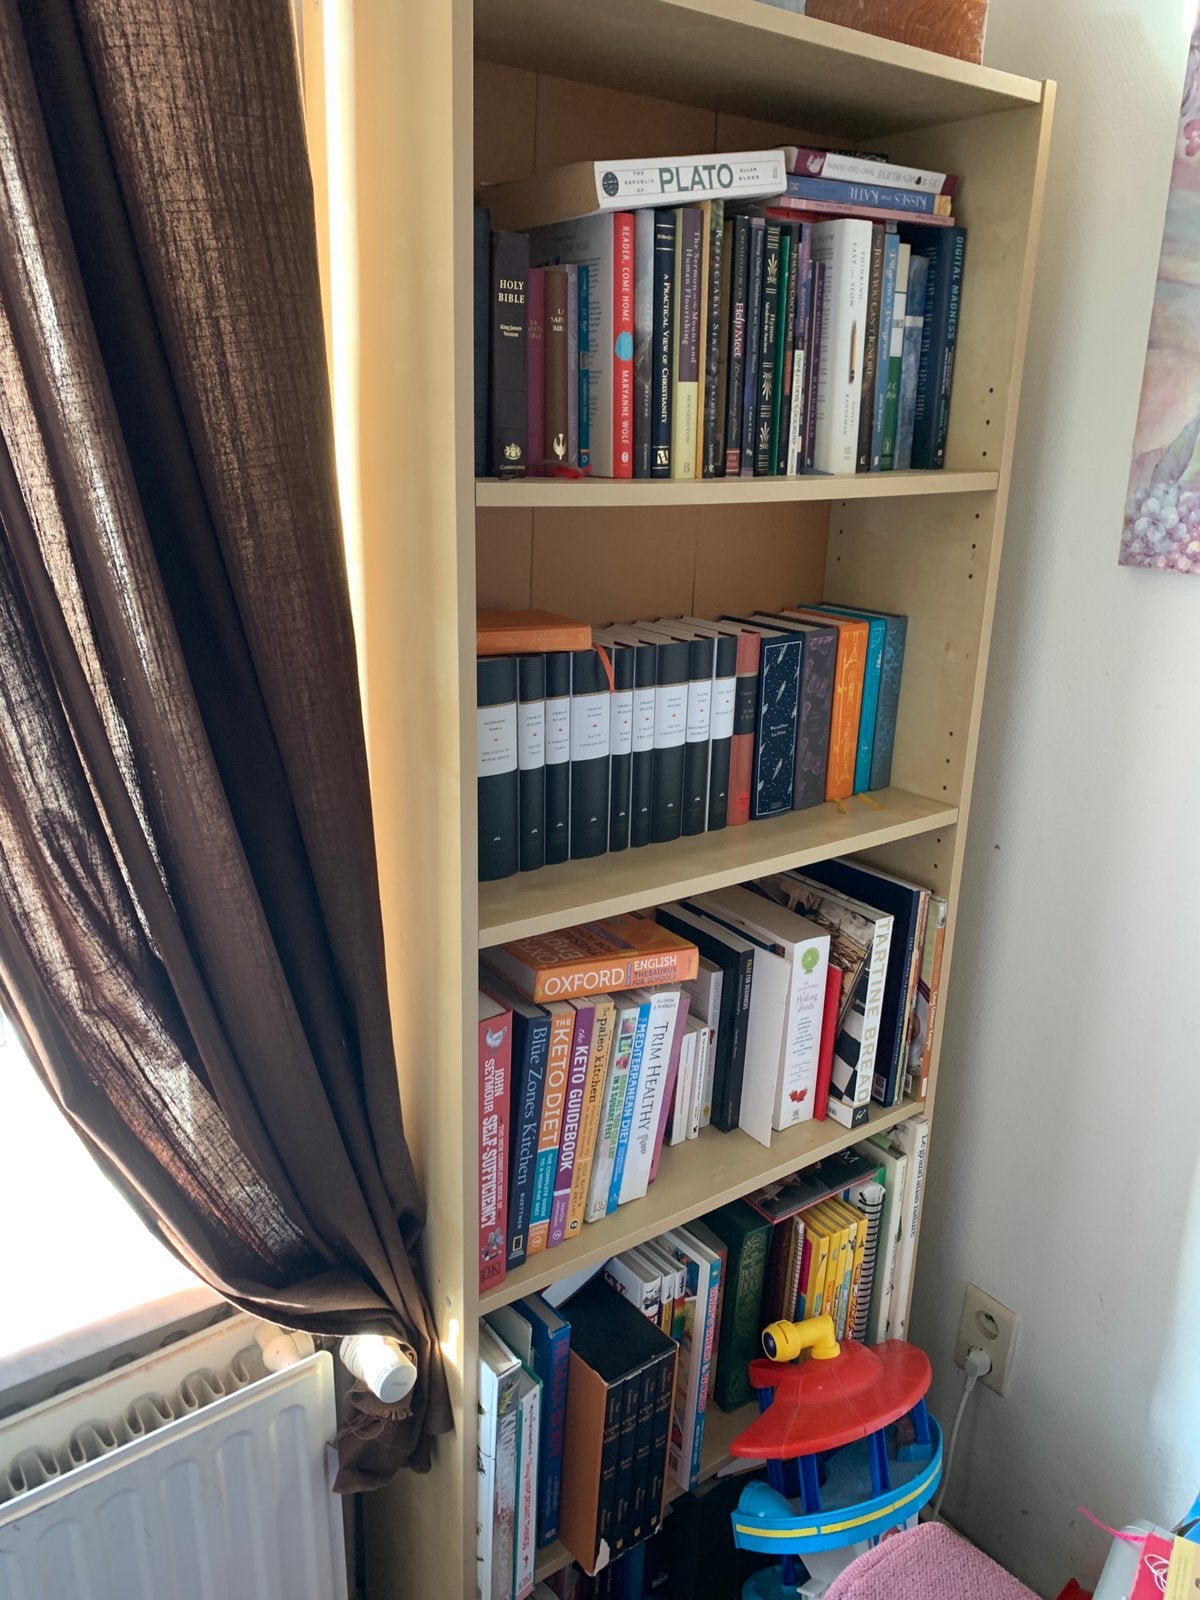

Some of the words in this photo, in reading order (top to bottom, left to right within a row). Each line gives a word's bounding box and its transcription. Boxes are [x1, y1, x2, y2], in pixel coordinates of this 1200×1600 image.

[659, 164, 733, 193] PLATO
[849, 186, 879, 204] KATIE
[895, 193, 927, 209] KISSES
[622, 225, 630, 263] READER,
[692, 230, 700, 249] The
[692, 252, 700, 291] Sermon
[753, 257, 761, 277] Godly
[873, 248, 881, 276] JESUS
[953, 236, 964, 280] DIGITAL
[498, 293, 525, 303] BIBLE
[500, 280, 524, 290] HOLY
[871, 277, 879, 299] YOU
[661, 282, 670, 328] PRACTICAL
[682, 288, 692, 345] Flourishing
[733, 302, 744, 328] Help
[947, 285, 960, 339] MADNESS
[661, 331, 670, 352] VIEW
[690, 312, 698, 343] Mount
[734, 330, 743, 357] Meet
[881, 307, 893, 360] Progress
[867, 336, 876, 376] IGNORE
[621, 370, 629, 417] MARYANNE
[661, 368, 669, 424] CHRISTIANITY
[621, 421, 629, 444] WOLF
[634, 955, 677, 971] ENGLISH
[634, 967, 677, 978] THESAURUS
[866, 918, 891, 1022] TARTINE
[545, 968, 624, 995] OXFORD
[647, 975, 676, 984] SCHOOLS
[531, 1027, 547, 1064] Blue
[577, 1029, 585, 1043] the
[595, 1018, 607, 1052] paleo
[648, 1022, 668, 1061] TRIM
[548, 1029, 570, 1087] KETO
[572, 1046, 588, 1084] KETO
[623, 1024, 647, 1117] MEDITERRANEAN
[858, 1026, 878, 1102] BREAD
[483, 1060, 494, 1113] SEYMOUR
[494, 1067, 504, 1096] JOHN
[524, 1069, 542, 1118] Zones
[589, 1056, 603, 1103] kitchen
[607, 1093, 617, 1119] SQUARE
[638, 1065, 662, 1130] HEALTHY
[542, 1094, 561, 1143] DIET
[560, 1090, 580, 1172] GUIDEBOOK
[605, 1120, 613, 1139] FEET
[619, 1120, 632, 1144] DIET
[517, 1122, 537, 1186] Kitchen
[921, 1135, 927, 1148] Le
[481, 1115, 497, 1228] SELF-SUFFICIENCY
[916, 1149, 925, 1179] grand
[543, 1167, 551, 1195] COMPLETE
[914, 1181, 922, 1203] atlas
[517, 1192, 525, 1229] BUETTNER
[540, 1197, 548, 1217] GUIDE
[910, 1205, 919, 1238] nature
